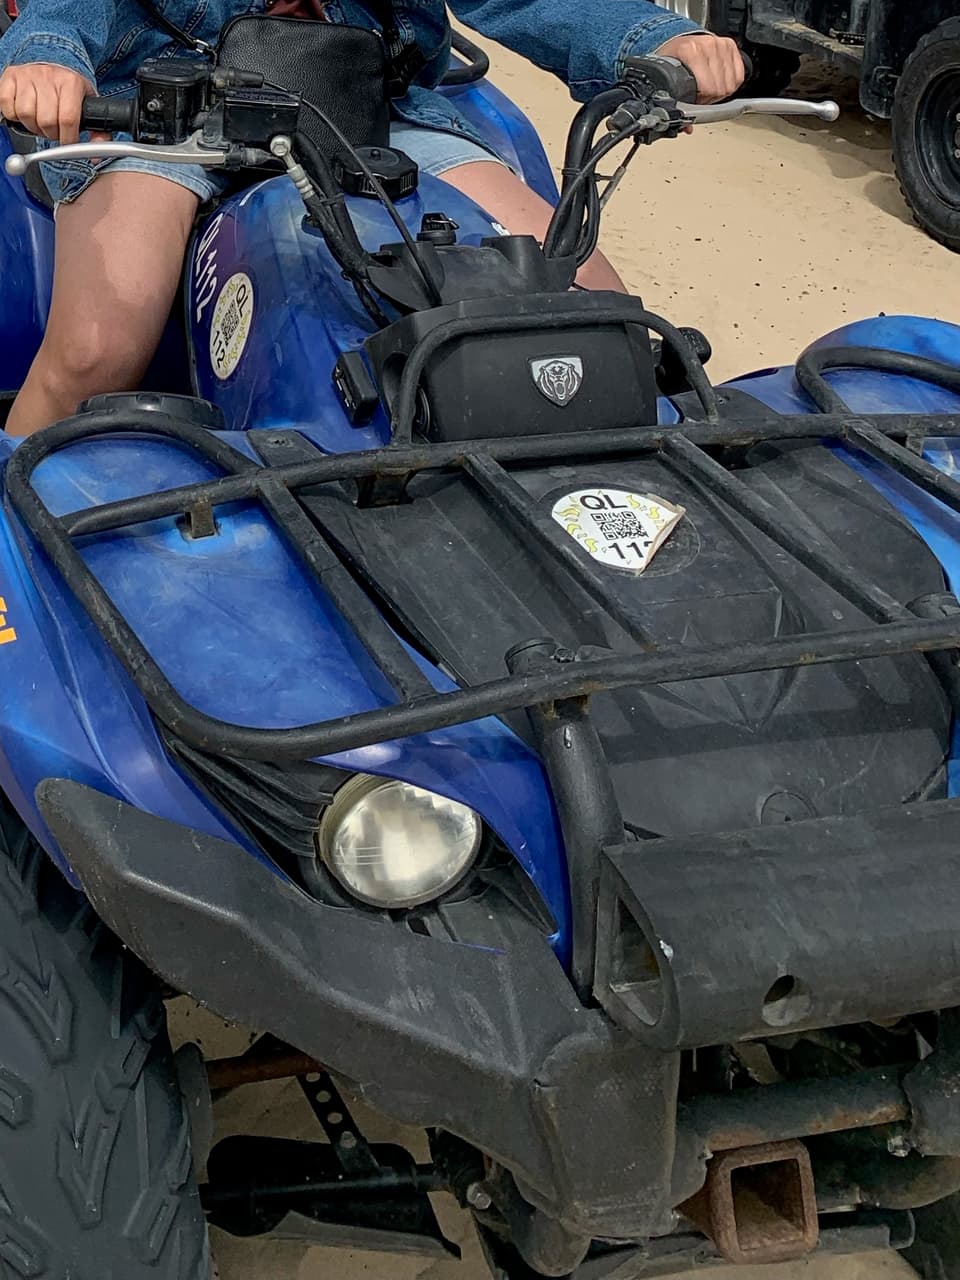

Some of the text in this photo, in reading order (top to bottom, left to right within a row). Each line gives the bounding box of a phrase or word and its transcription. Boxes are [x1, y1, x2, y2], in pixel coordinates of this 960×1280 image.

[236, 284, 249, 318] QL
[212, 330, 226, 369] 112
[579, 494, 629, 510] QL
[607, 540, 654, 560] 11
